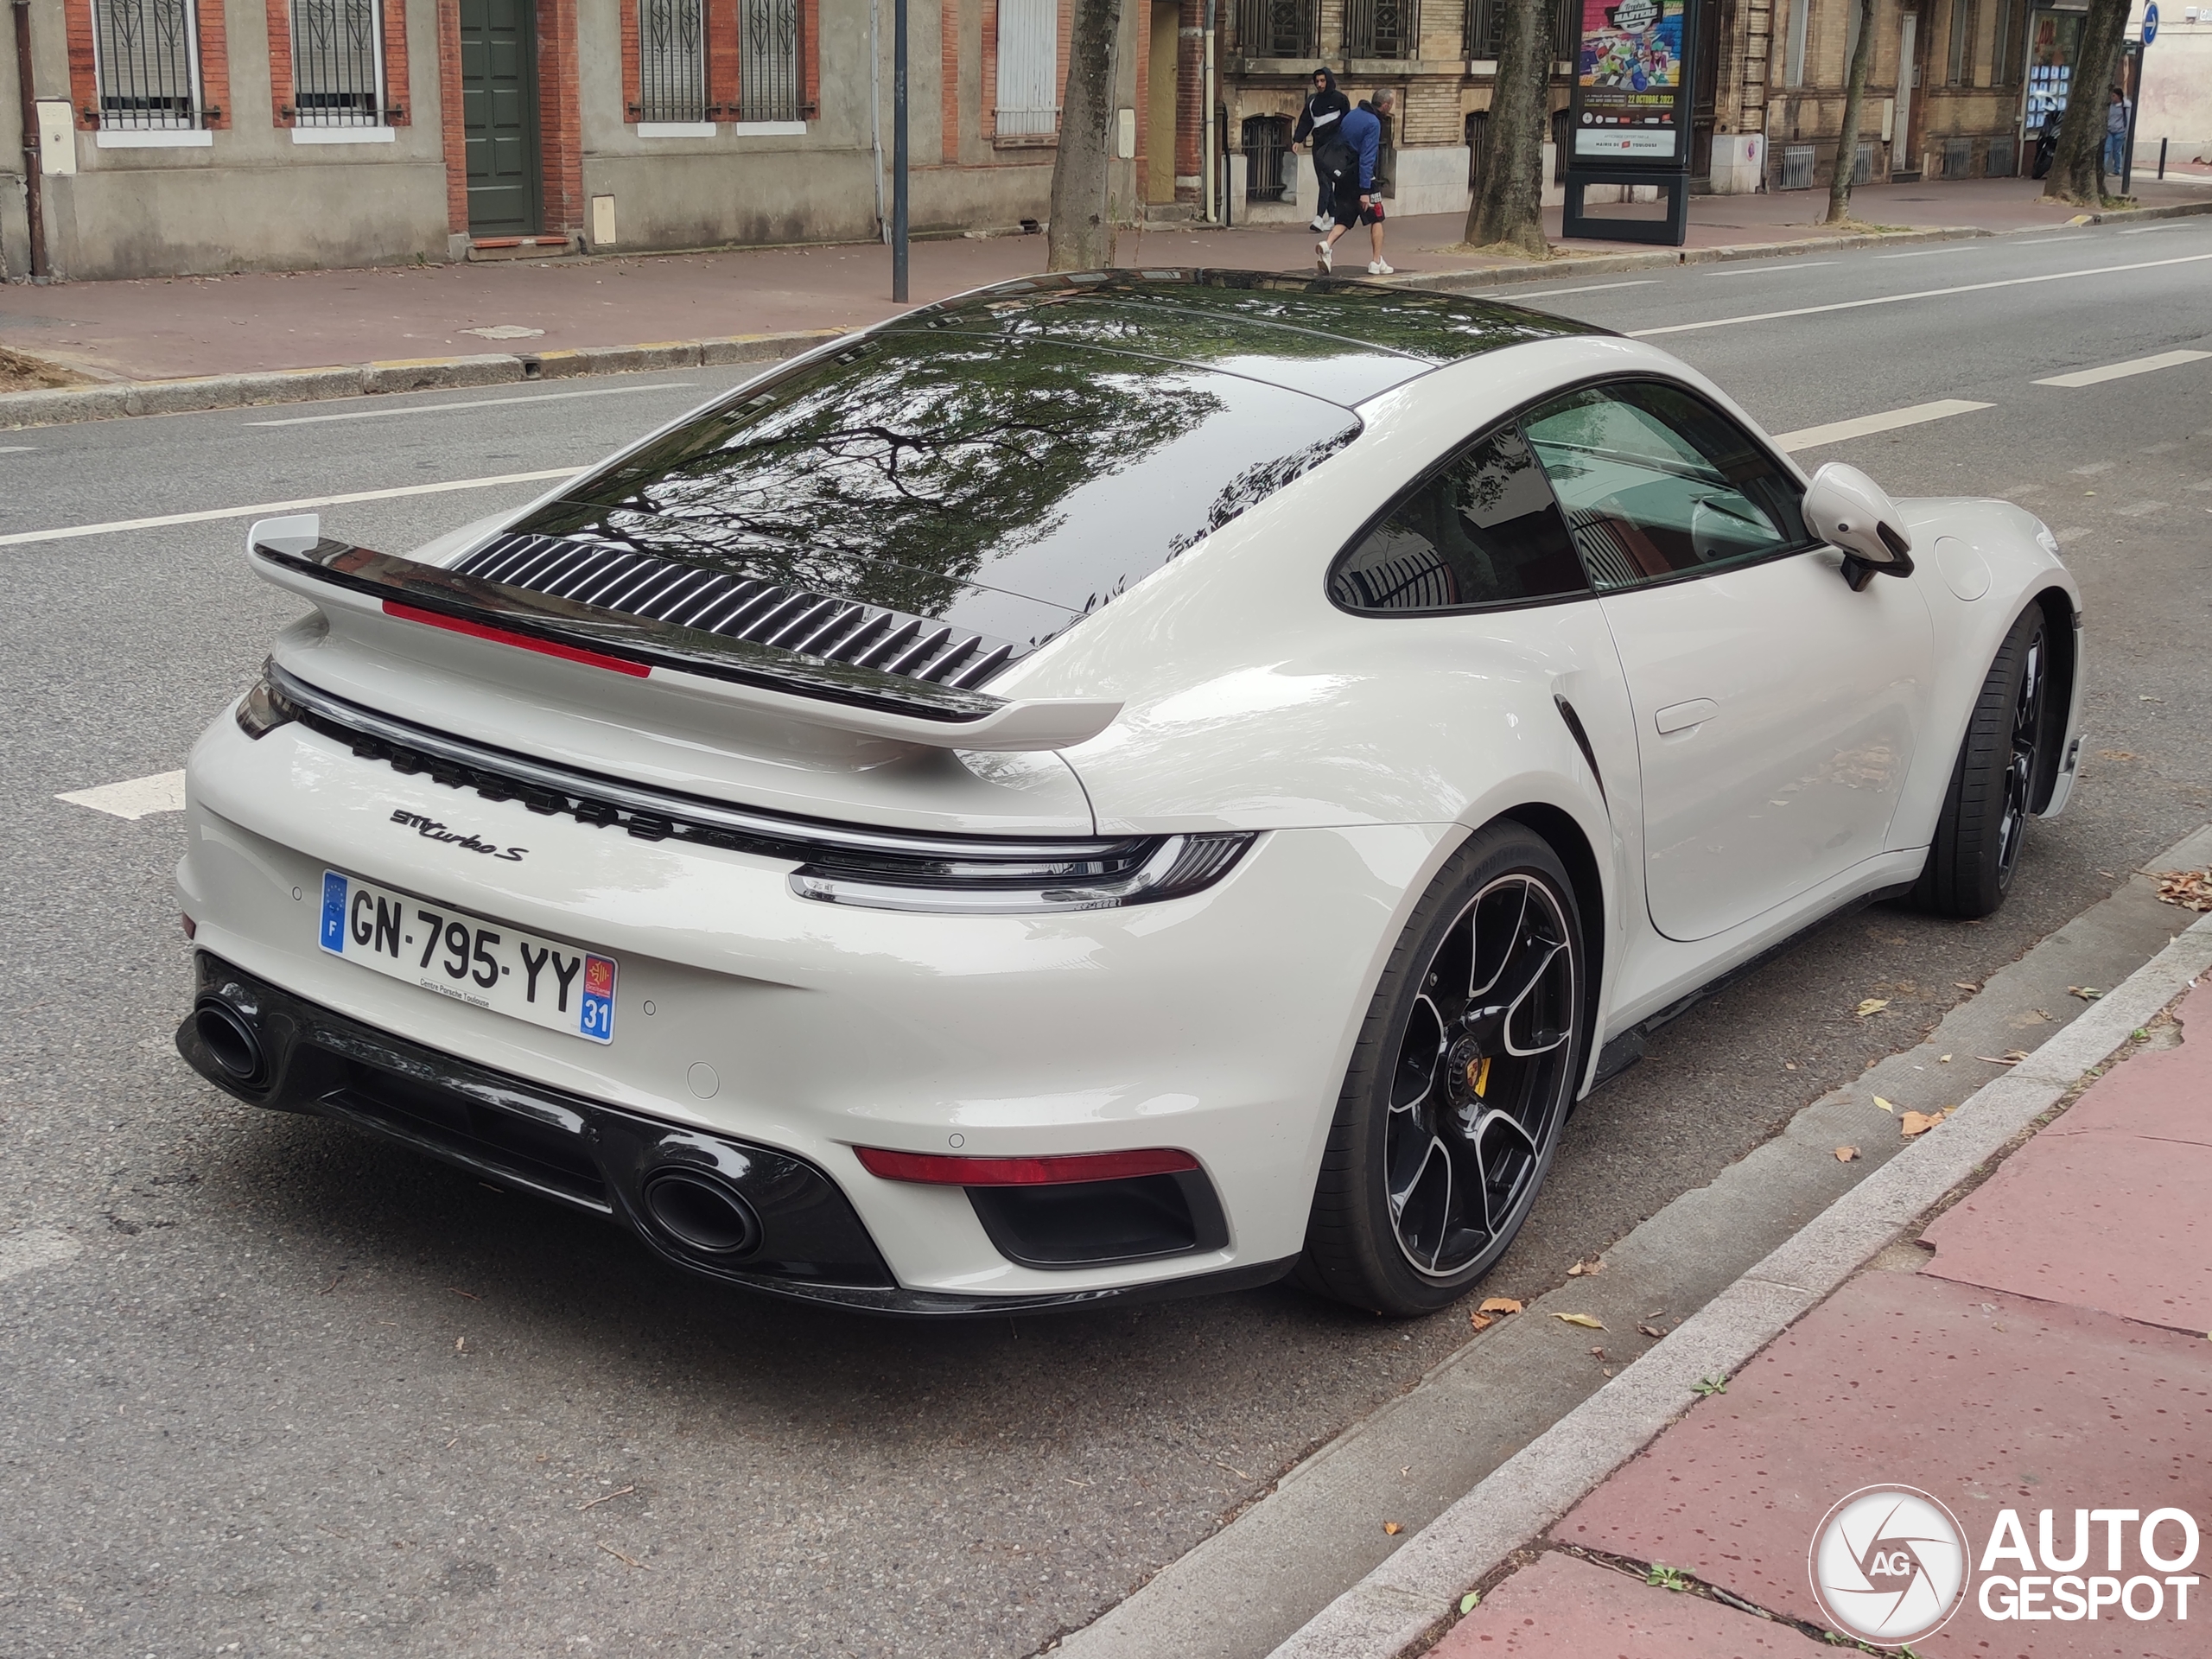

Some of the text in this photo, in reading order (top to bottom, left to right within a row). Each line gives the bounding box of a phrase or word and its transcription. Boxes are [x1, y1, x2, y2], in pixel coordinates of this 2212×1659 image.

[1614, 8, 1657, 22] MASTERS
[1628, 95, 1635, 104] 22
[1636, 95, 1659, 104] OCTOBRE
[1660, 95, 1674, 104] 2023
[493, 848, 530, 861] S
[1465, 846, 1531, 889] GOODYEAR
[328, 920, 337, 937] F
[351, 889, 581, 1014] GN-795-YY
[420, 978, 490, 1007] Centre Porsche Toulouse
[584, 999, 608, 1033] 31
